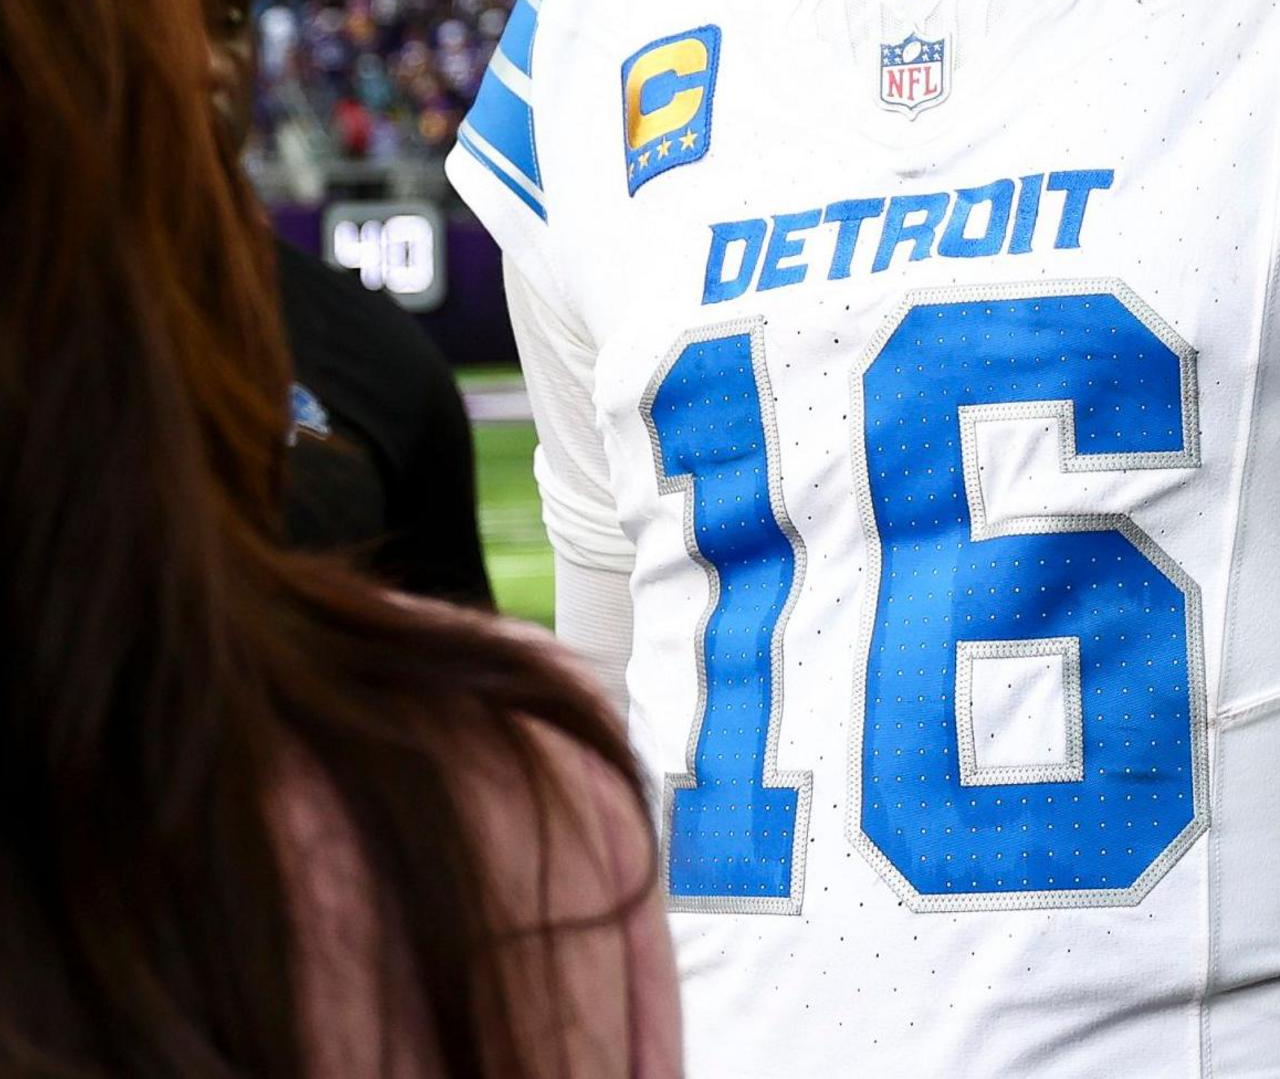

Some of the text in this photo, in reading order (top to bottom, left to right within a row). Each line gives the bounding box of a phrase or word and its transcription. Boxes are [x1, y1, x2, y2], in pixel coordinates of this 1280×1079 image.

[628, 39, 708, 150] C
[886, 66, 938, 101] NFL
[334, 215, 433, 294] 40
[701, 169, 1115, 306] DETROIT
[639, 278, 1210, 916] 16
